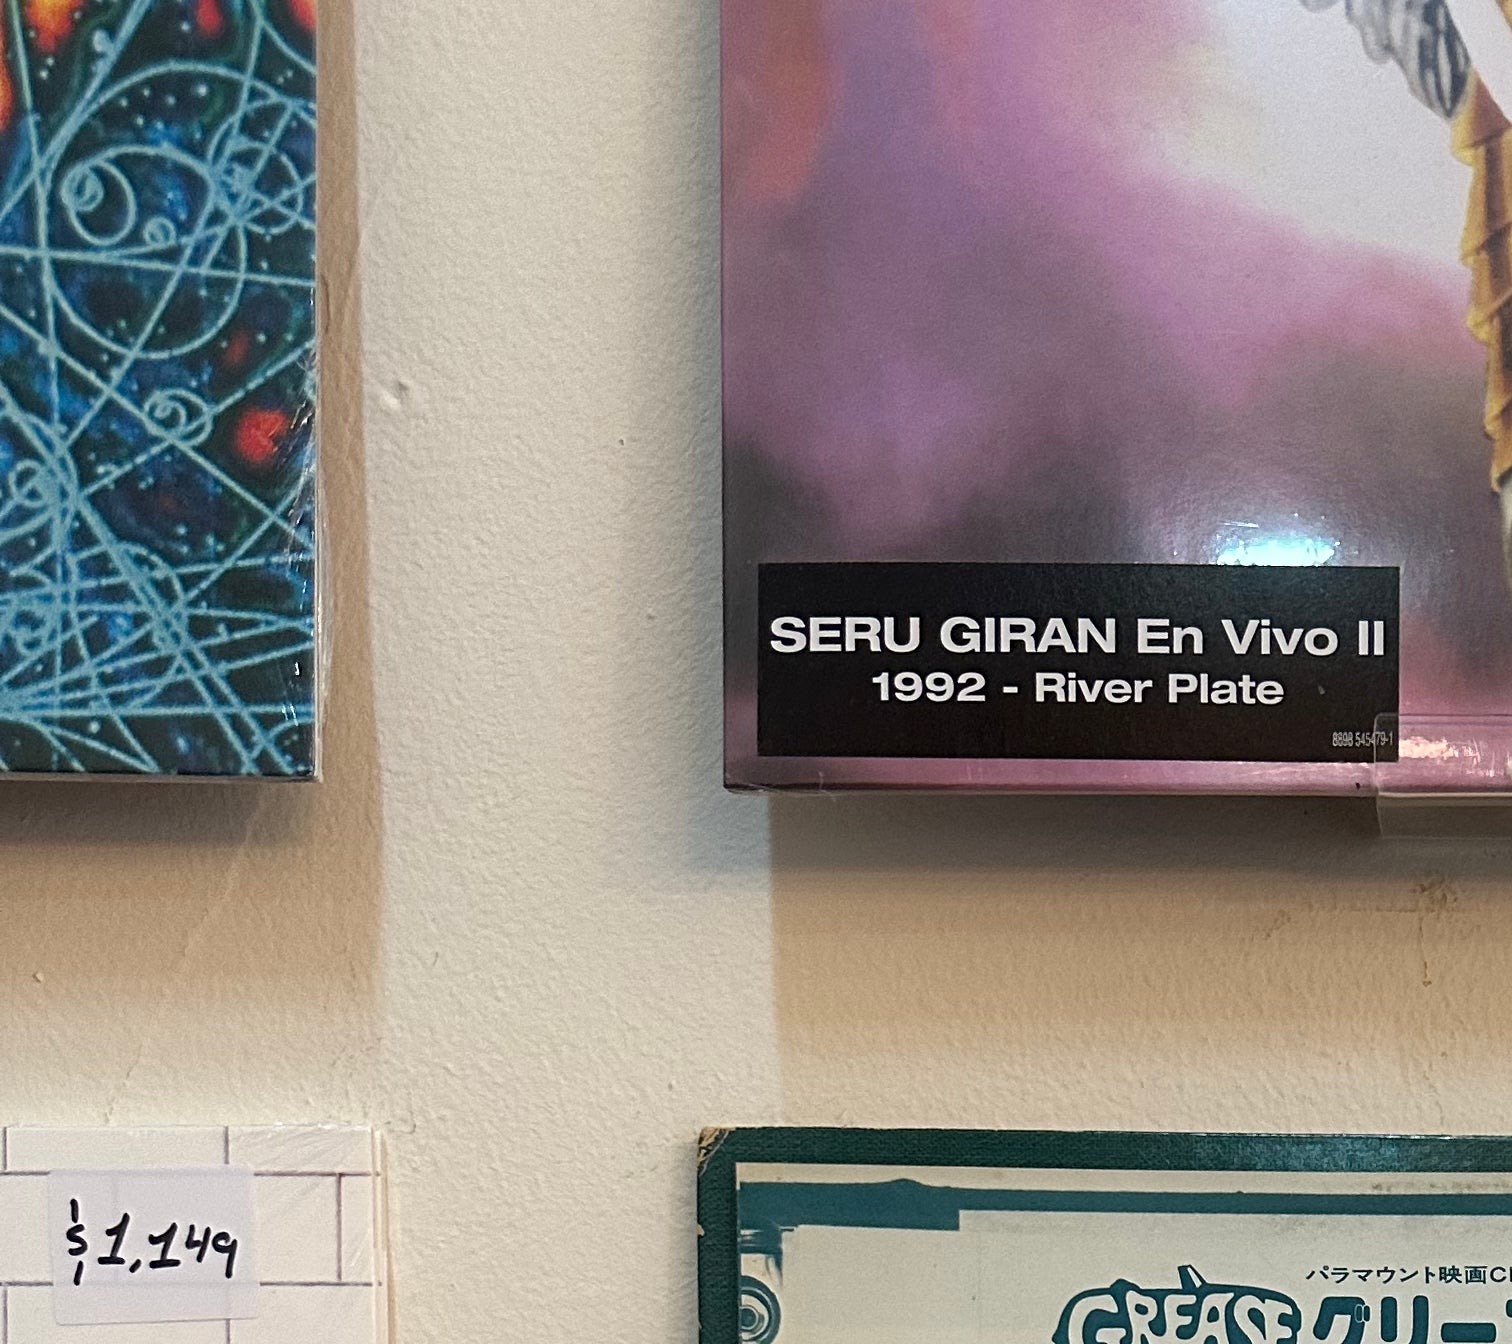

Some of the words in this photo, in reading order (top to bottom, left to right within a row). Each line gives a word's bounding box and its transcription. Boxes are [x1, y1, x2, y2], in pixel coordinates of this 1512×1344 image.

[770, 616, 920, 653] SERU
[940, 616, 1116, 654] GIRAN
[1137, 618, 1204, 655] En
[1221, 618, 1339, 656] Vivo
[1358, 621, 1385, 656] II
[872, 672, 986, 702] 1992
[1035, 672, 1153, 703] River
[1168, 673, 1285, 705] Plate
[66, 1199, 238, 1286] $1,149
